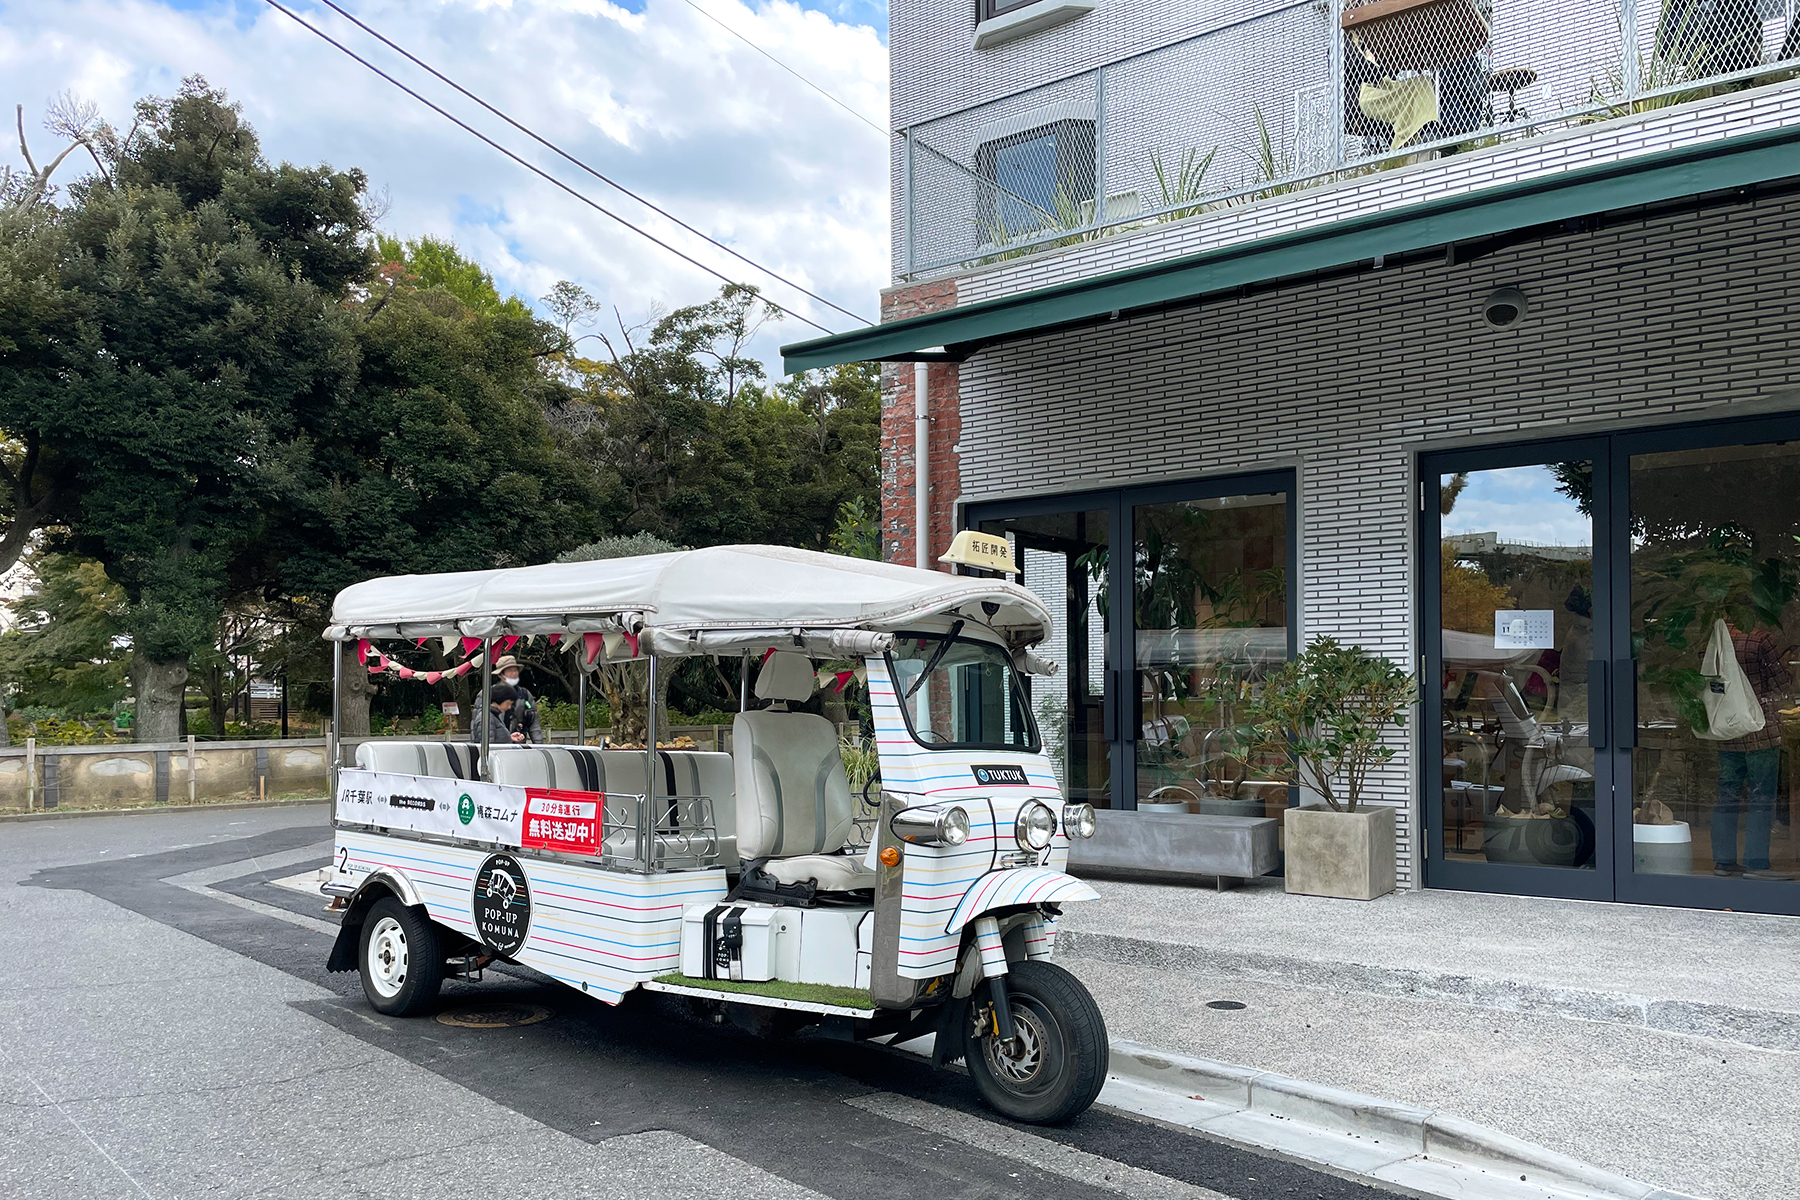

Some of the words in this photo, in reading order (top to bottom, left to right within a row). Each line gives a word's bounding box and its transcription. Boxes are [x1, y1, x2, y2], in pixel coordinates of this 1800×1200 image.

[972, 540, 1007, 558] 拓匠開発
[988, 770, 1023, 780] TUKTUK
[341, 789, 372, 805] JR千葉駅
[541, 802, 581, 816] 30分毎運行
[1041, 843, 1052, 866] 2
[495, 859, 510, 867] POP-UP
[484, 907, 518, 924] POP-UP
[481, 921, 520, 938] KOMUNA
